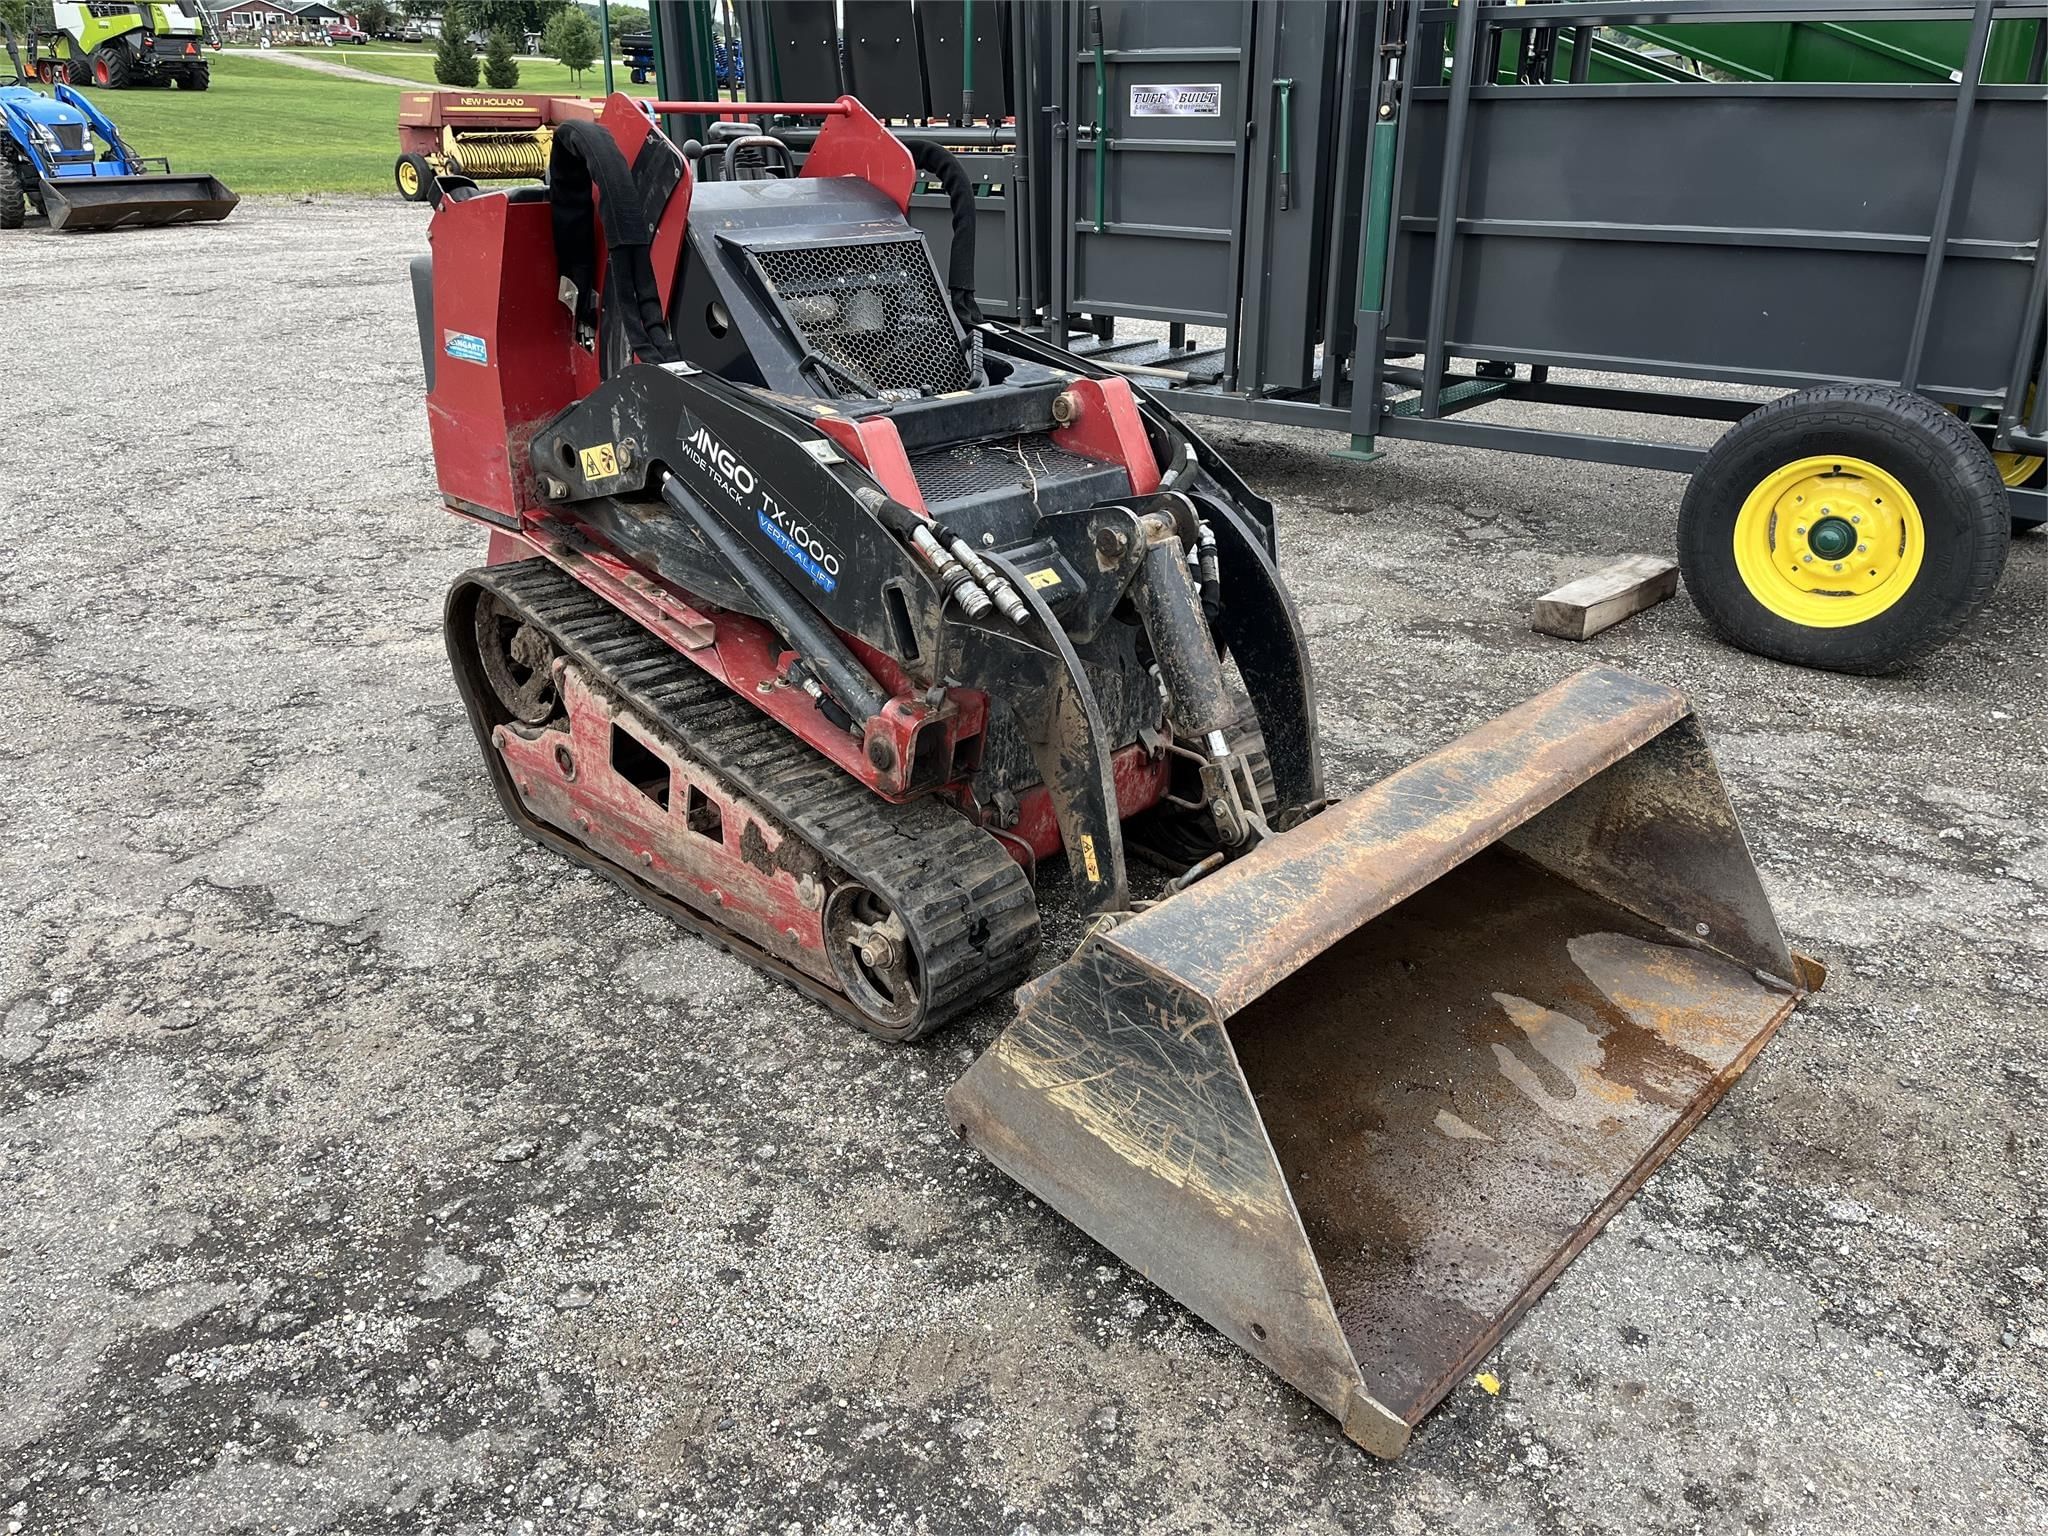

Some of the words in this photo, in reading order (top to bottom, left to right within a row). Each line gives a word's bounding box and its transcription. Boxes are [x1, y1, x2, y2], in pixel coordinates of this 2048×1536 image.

[461, 98, 481, 106] NEW
[483, 98, 524, 106] HOLLAND
[1134, 93, 1166, 103] TUFF
[1179, 93, 1216, 103] BUILT
[682, 440, 707, 472] WIDE
[708, 465, 744, 506] TRACK
[760, 515, 808, 569] VERTICAL
[811, 564, 833, 589] LIFT
